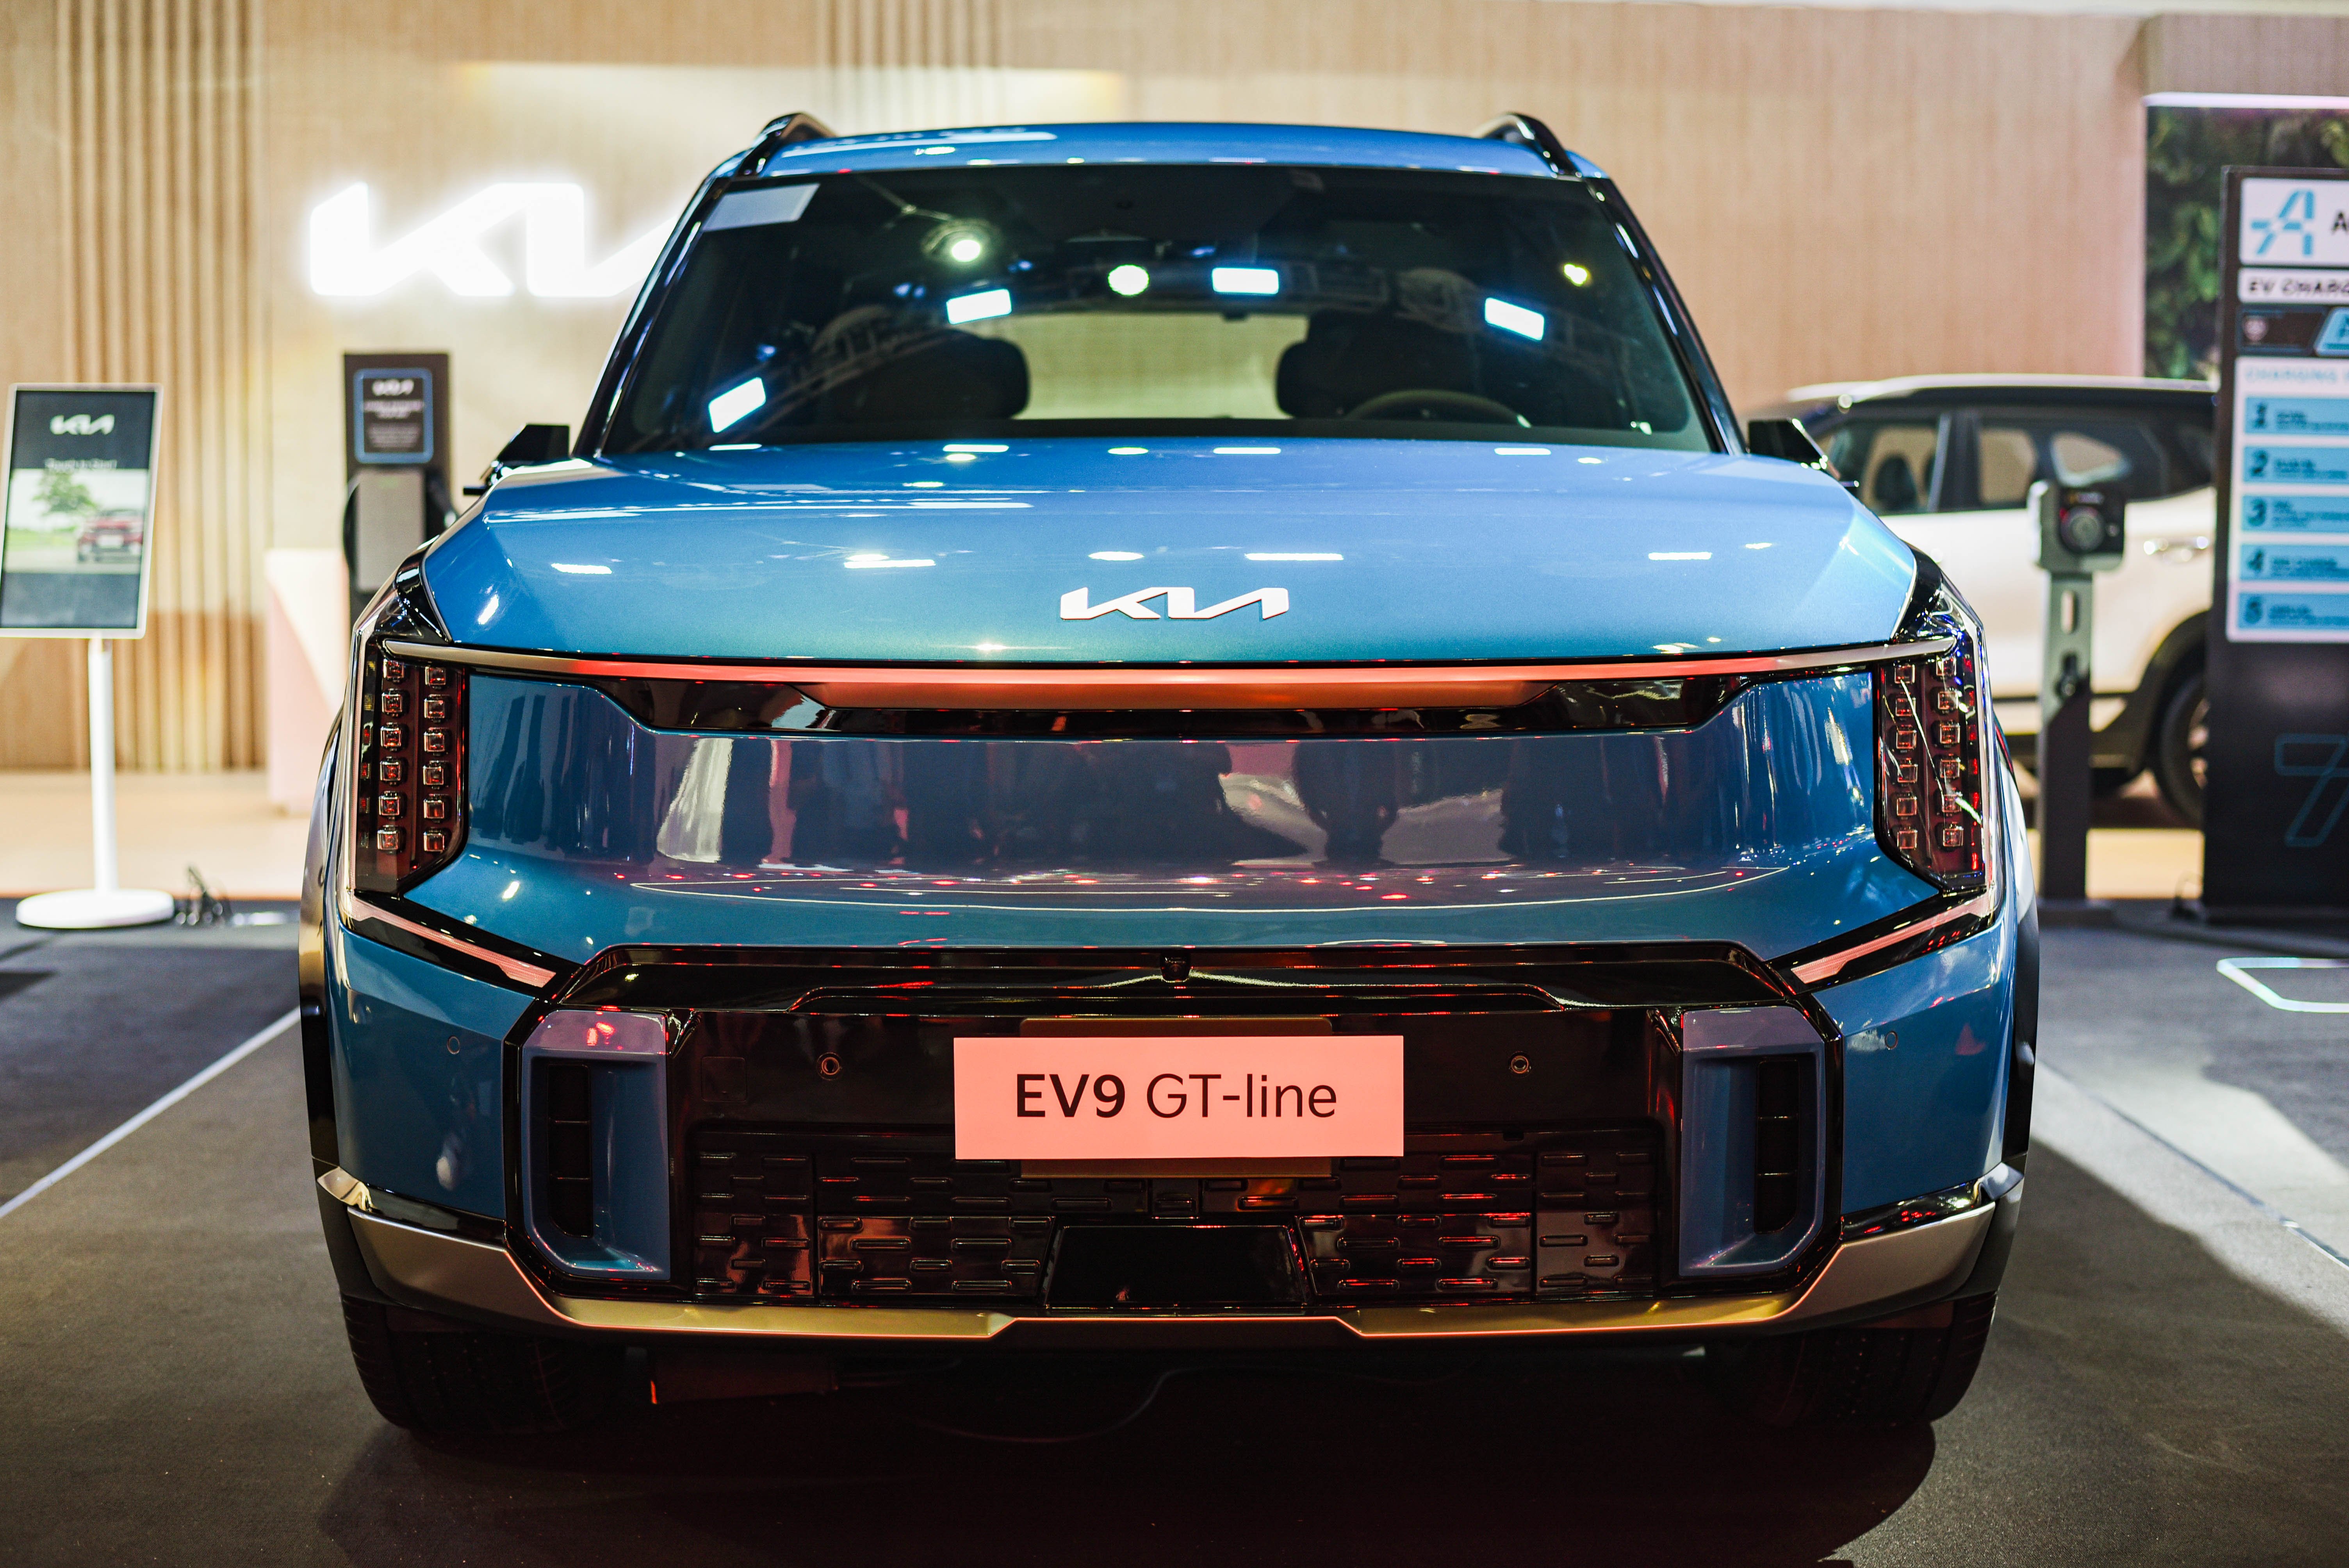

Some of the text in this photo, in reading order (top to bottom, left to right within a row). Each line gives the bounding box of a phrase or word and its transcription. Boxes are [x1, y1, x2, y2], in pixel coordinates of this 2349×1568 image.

[1060, 587, 1289, 620] KIA
[1016, 1074, 1337, 1118] EV9 GT-line
